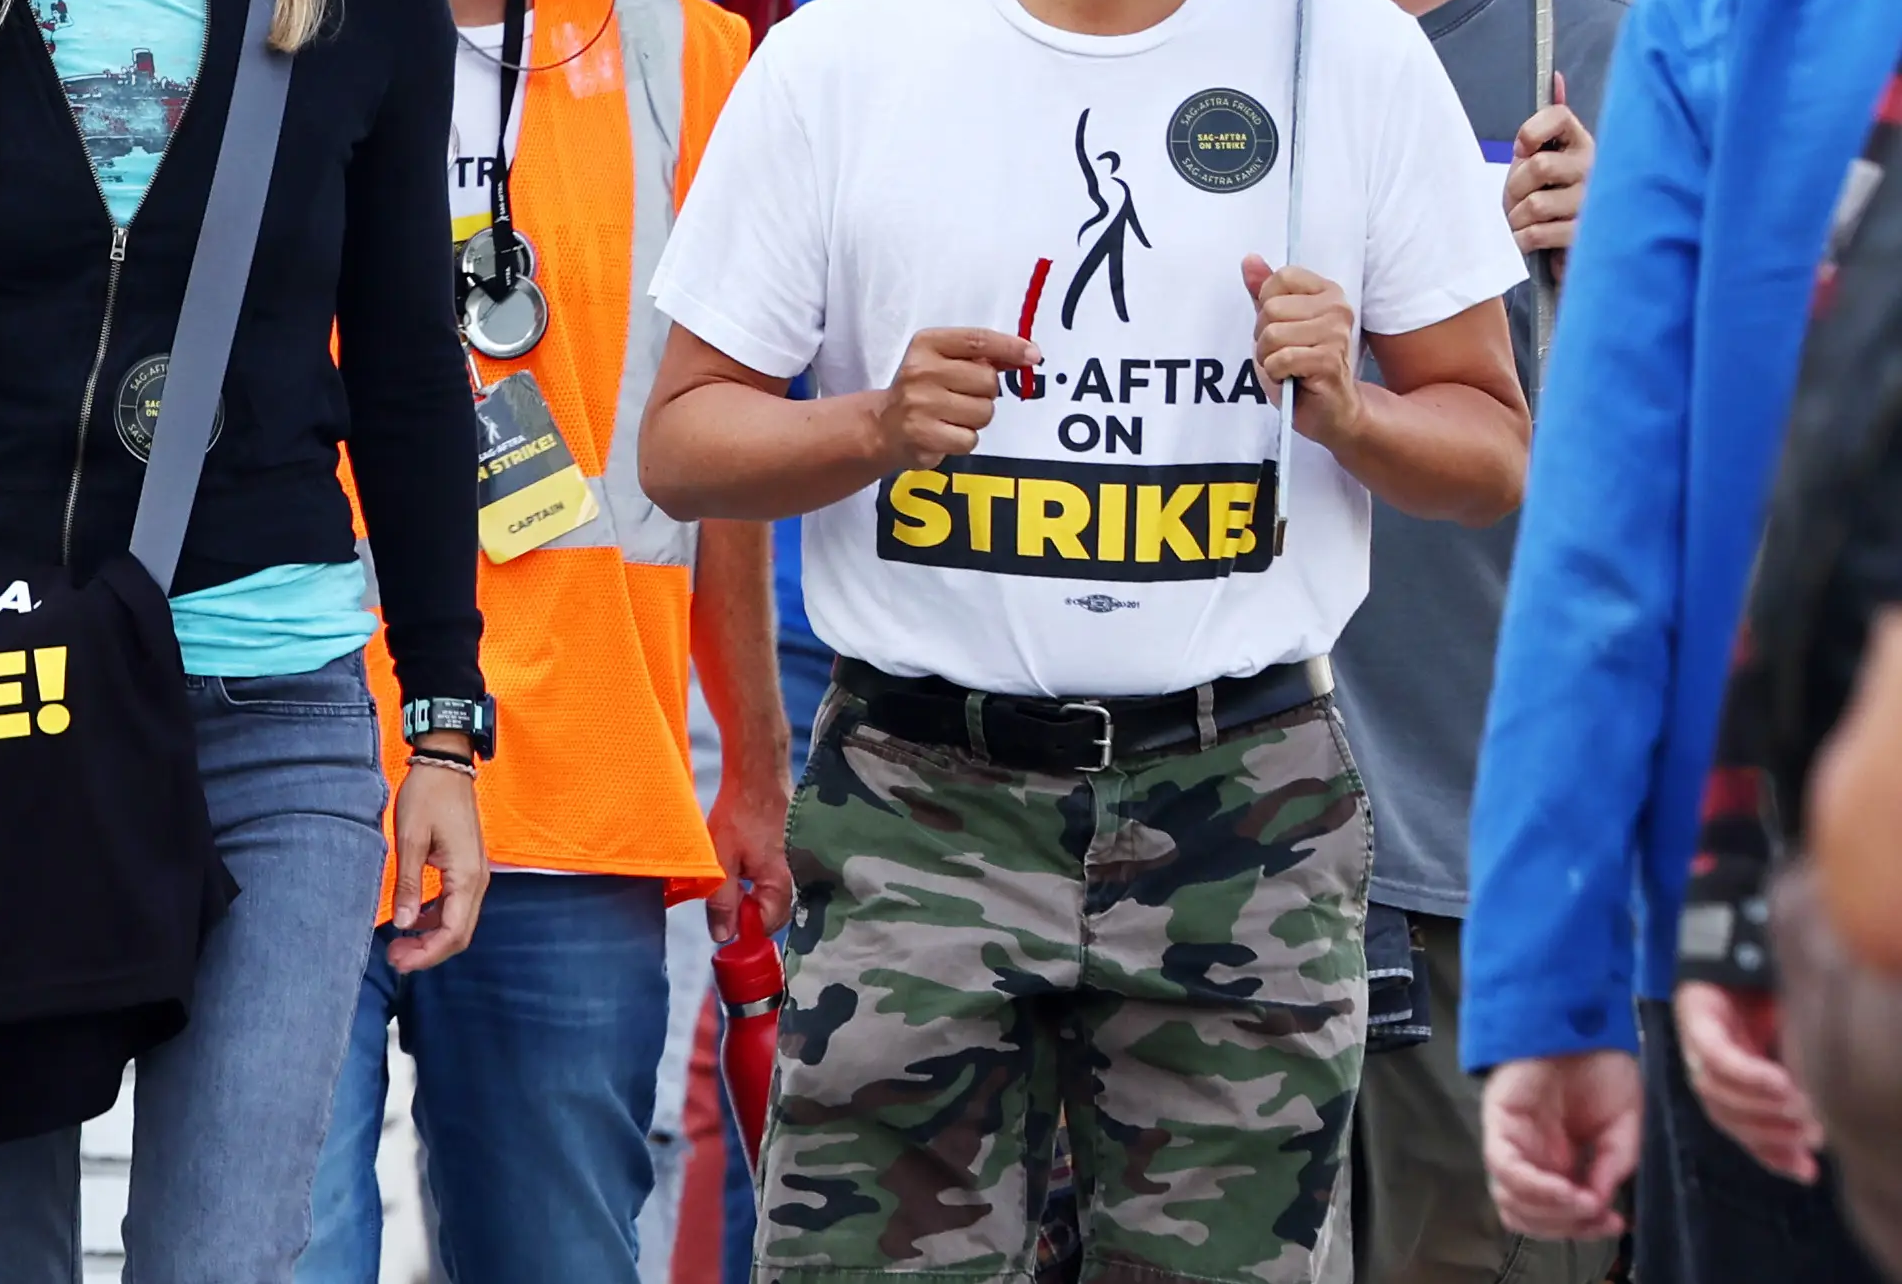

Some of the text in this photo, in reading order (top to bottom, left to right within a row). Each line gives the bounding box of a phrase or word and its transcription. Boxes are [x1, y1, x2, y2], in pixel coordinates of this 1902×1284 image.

[1232, 100, 1262, 126] FRIEND
[1197, 133, 1247, 141] SAG-AFTRA
[1199, 142, 1246, 150] ON STRIKE
[1235, 156, 1264, 182] FAMILY
[129, 364, 168, 391] SAG-AFT
[1058, 414, 1142, 455] ON
[489, 433, 558, 475] STRIKE!
[508, 501, 565, 535] CAPTAIN
